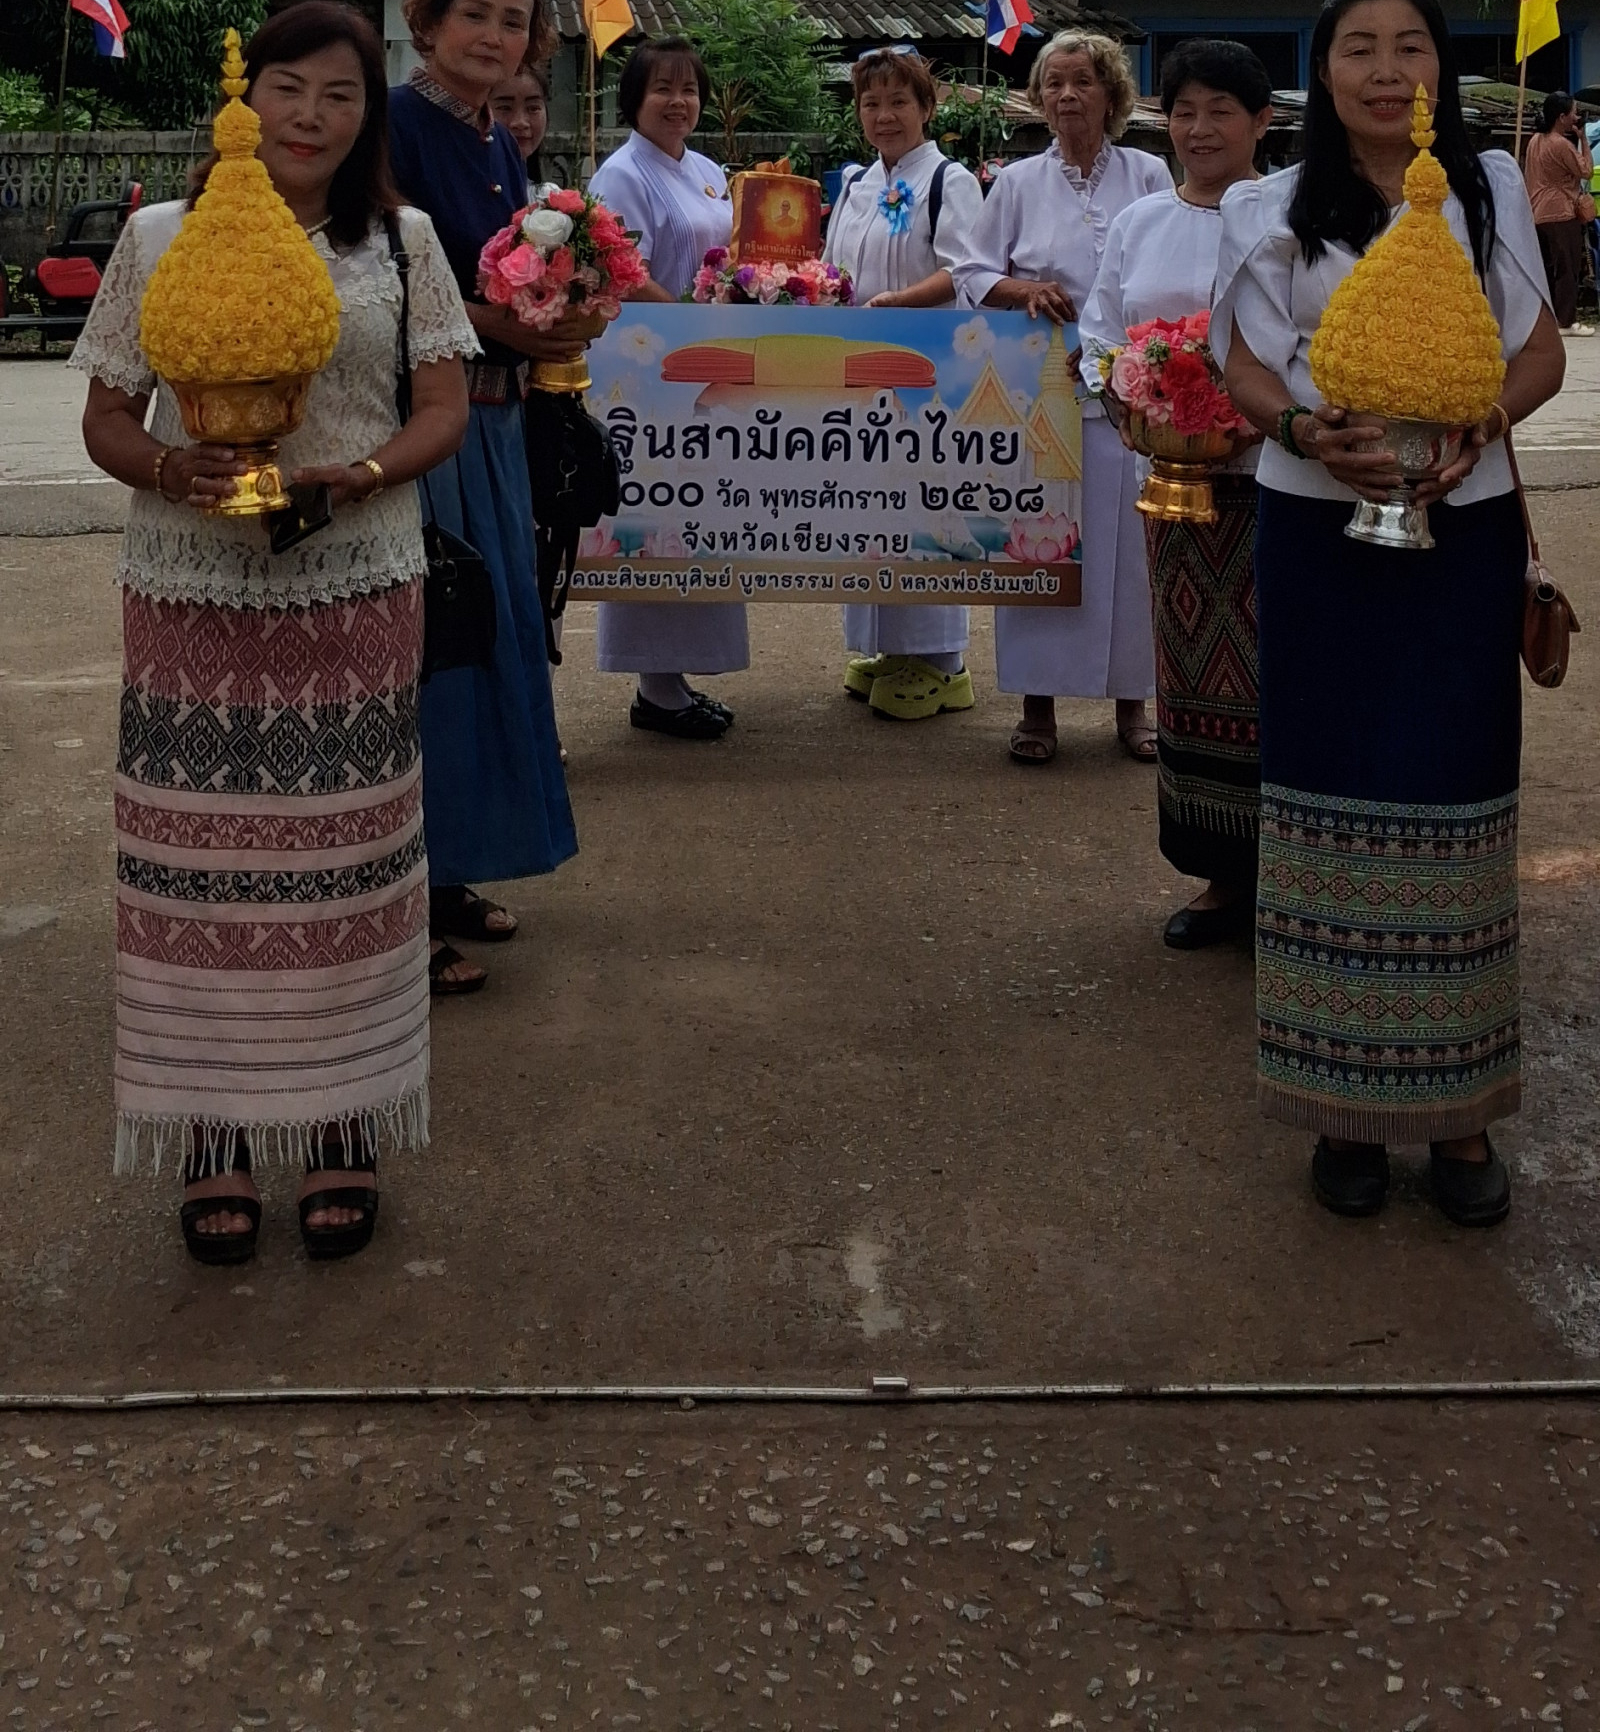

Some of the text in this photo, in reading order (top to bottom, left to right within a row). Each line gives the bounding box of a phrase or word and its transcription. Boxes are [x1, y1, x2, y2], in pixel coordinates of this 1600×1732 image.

[716, 478, 750, 508] วัด
[759, 479, 907, 519] พุทธศักราช
[919, 481, 1045, 513] ๒๕๖๘
[682, 521, 908, 554] จังหวัดเชียงราย
[573, 566, 731, 594] คณะศิษยานุศิษย์
[739, 573, 834, 595] บูชาธรรม
[842, 577, 870, 590] ๘๑
[879, 571, 892, 589] ปี
[901, 570, 1058, 592] หลวงพ่อธัมมชโย
